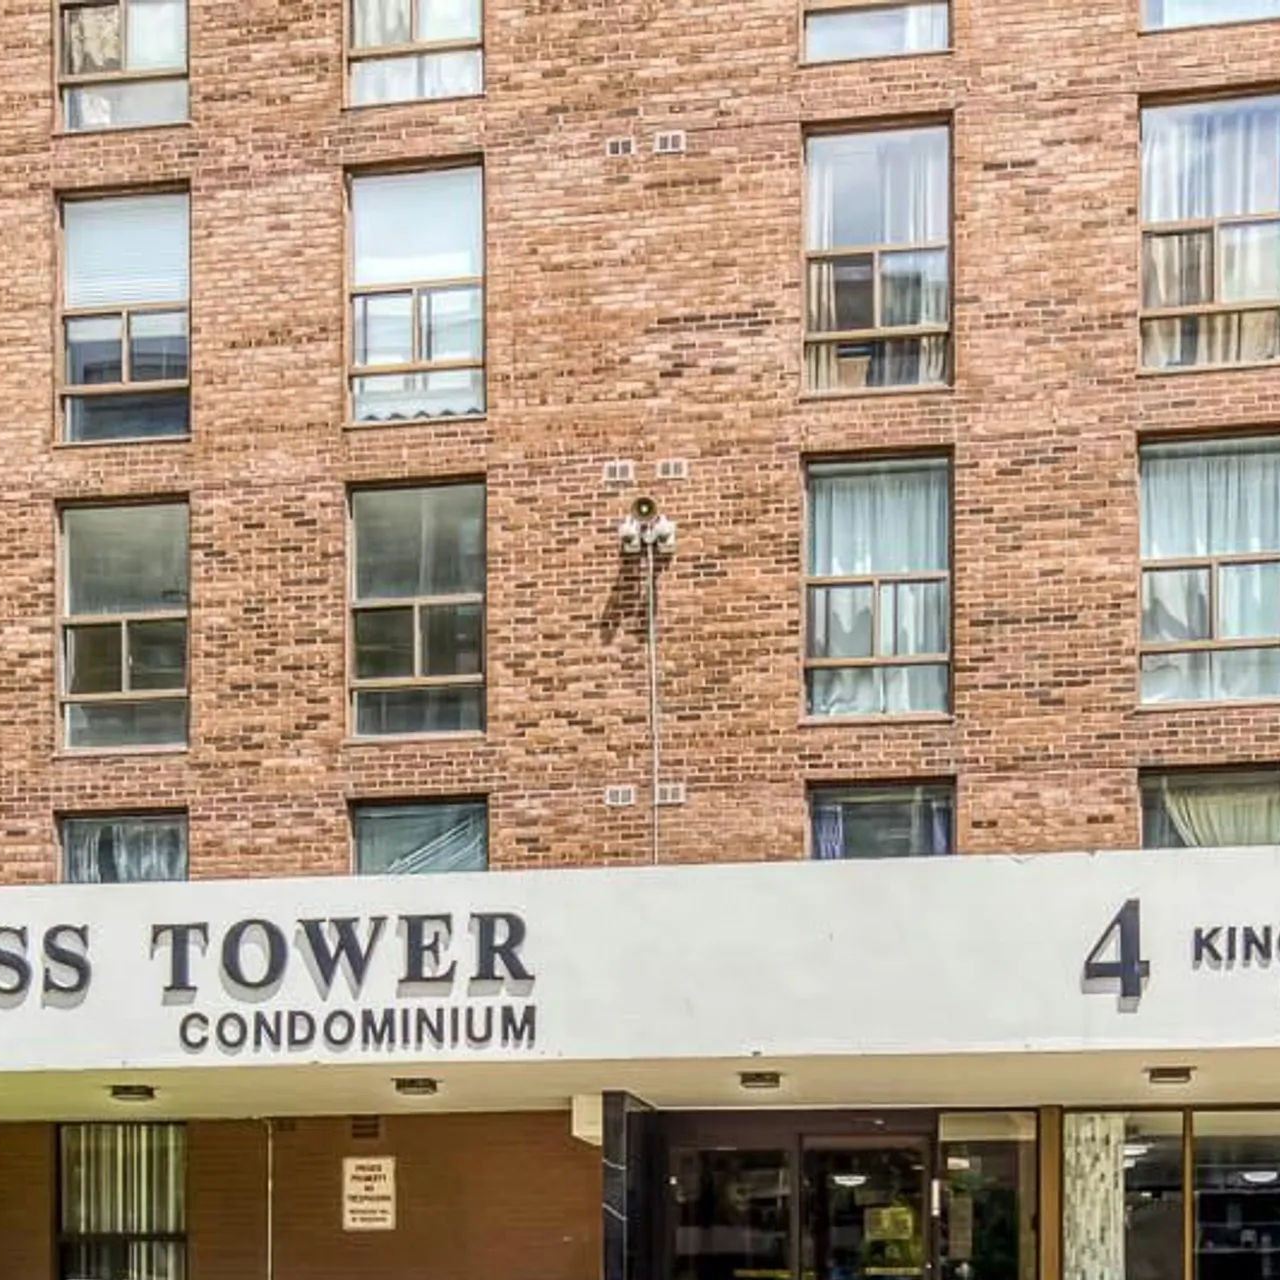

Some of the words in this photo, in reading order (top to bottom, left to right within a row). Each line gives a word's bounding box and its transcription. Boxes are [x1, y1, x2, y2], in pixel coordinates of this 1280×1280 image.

[151, 911, 536, 993] TOWER
[1084, 898, 1151, 1000] 4
[178, 1004, 537, 1050] CONDOMINIUM
